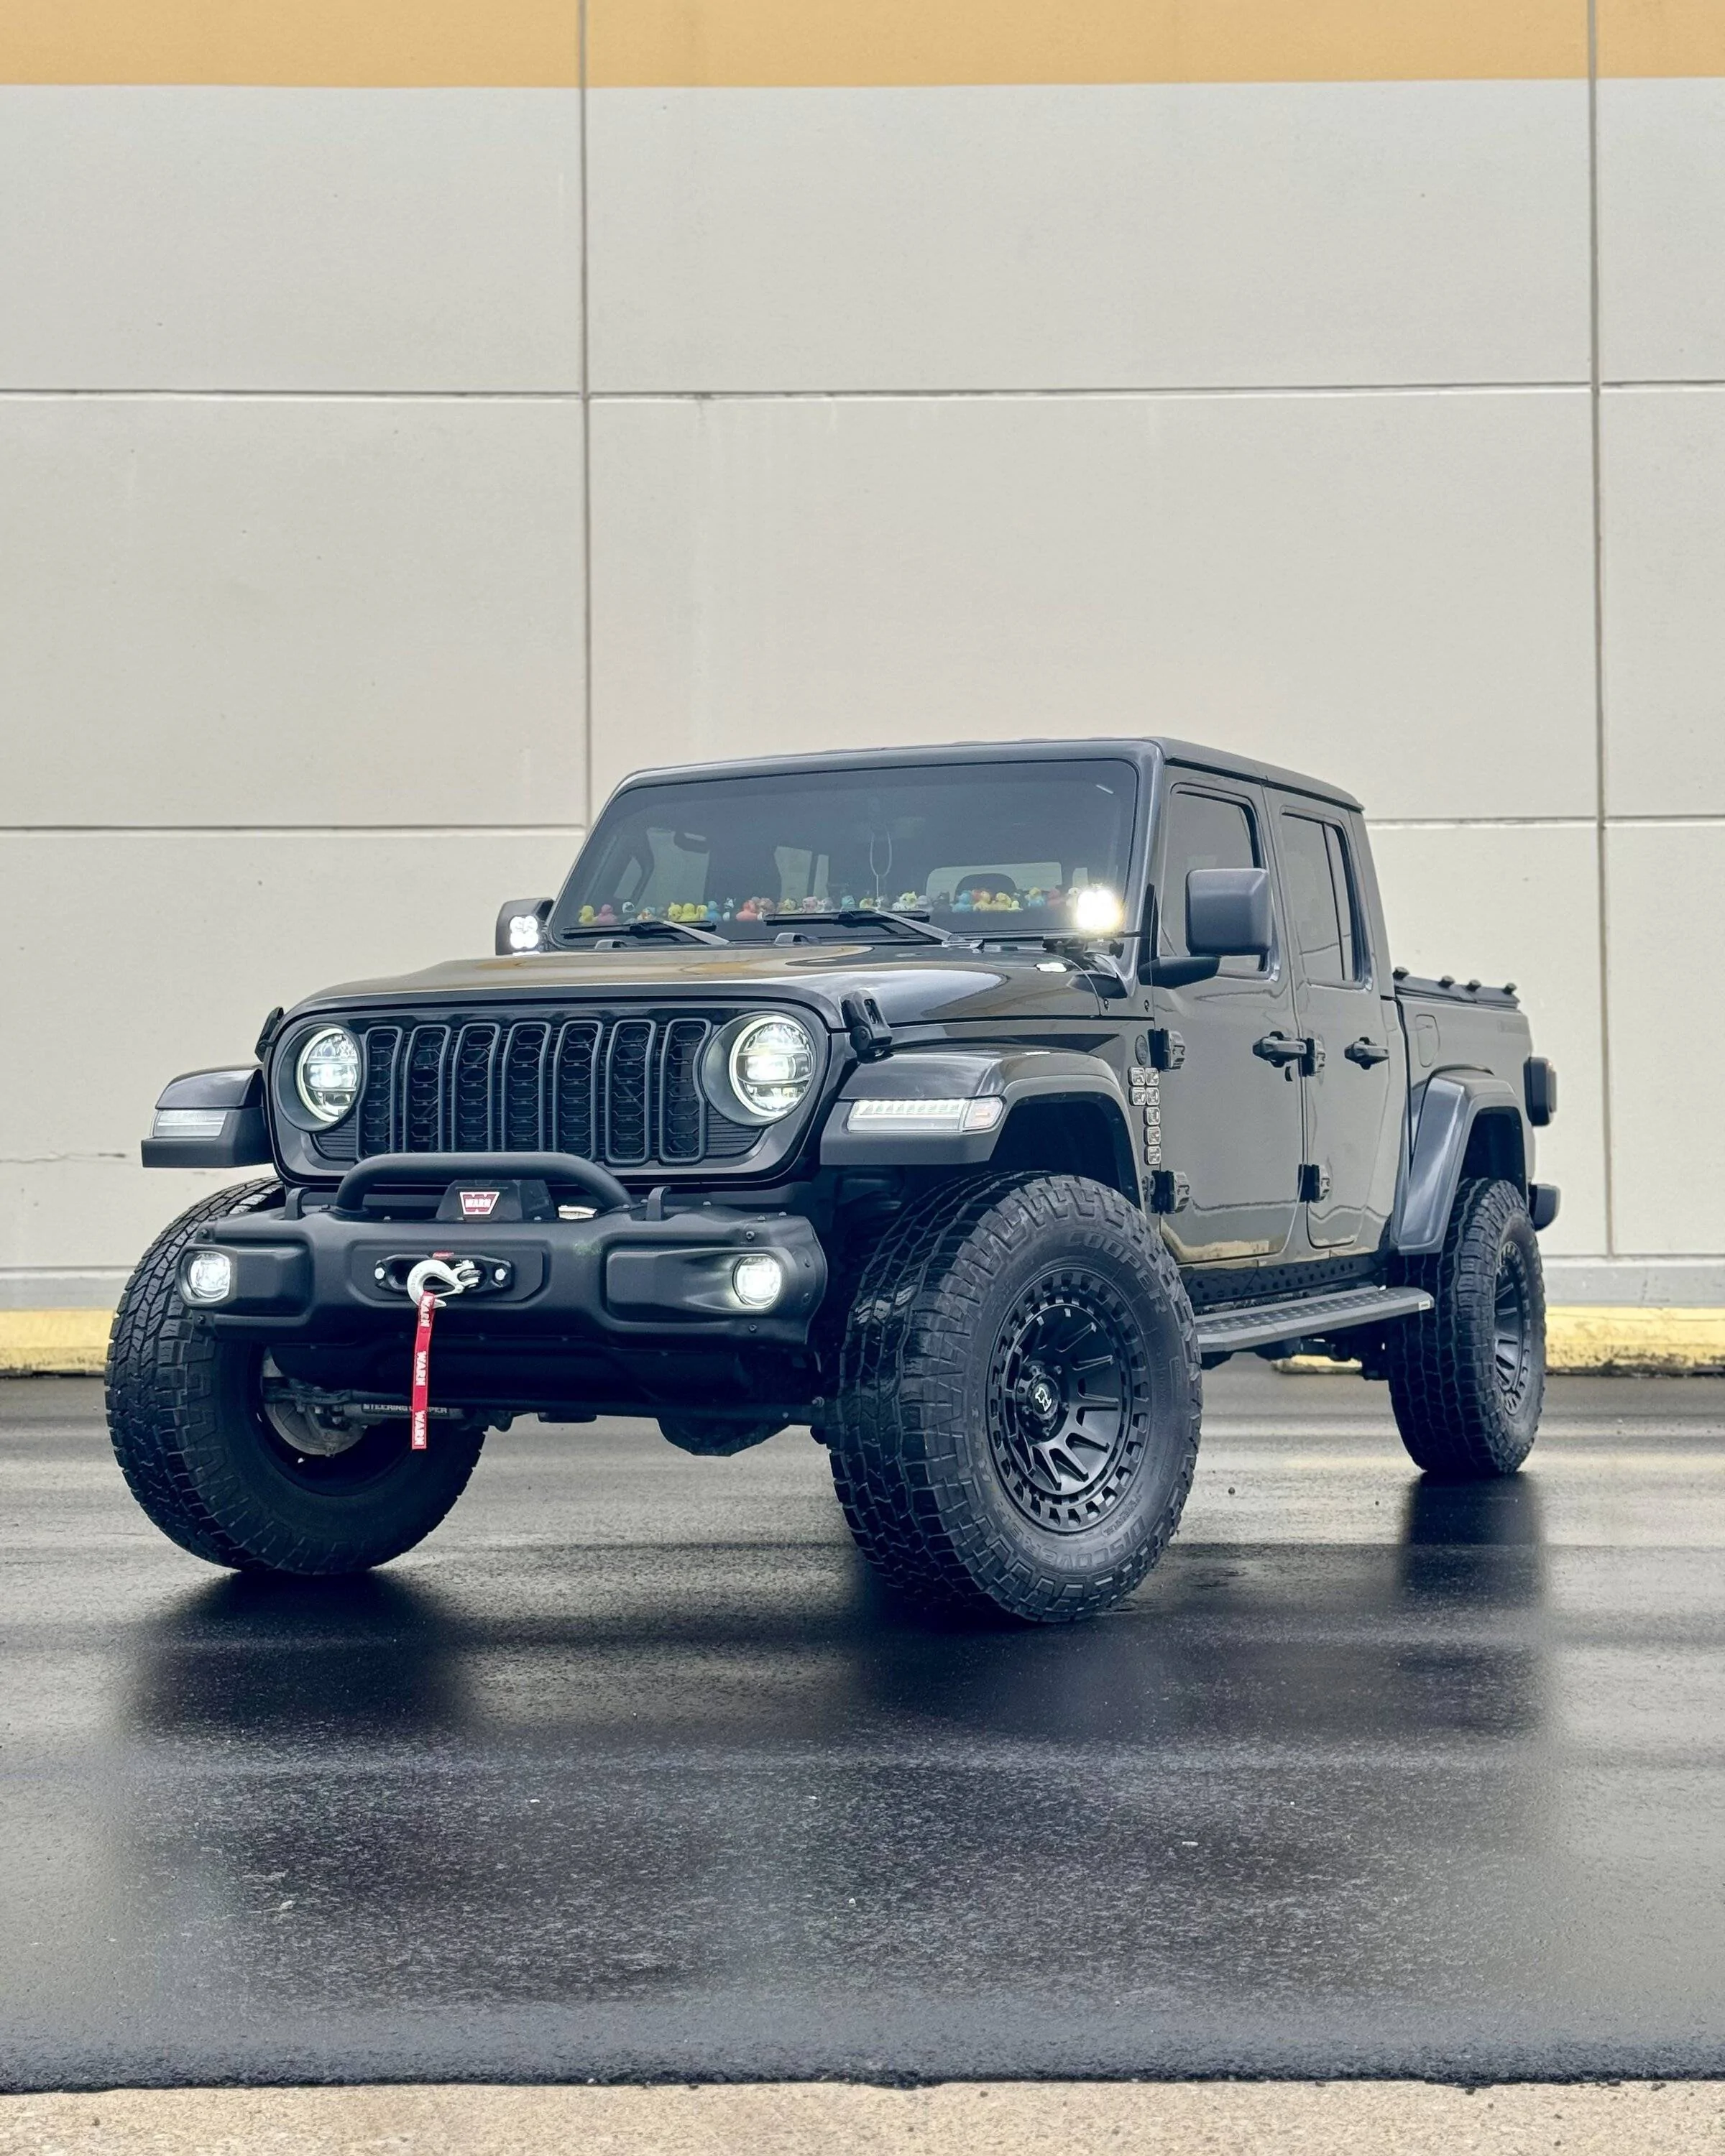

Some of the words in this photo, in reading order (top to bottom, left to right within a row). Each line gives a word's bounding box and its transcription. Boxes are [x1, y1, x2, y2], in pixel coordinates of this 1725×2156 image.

[1069, 1231, 1169, 1315] COOPER
[420, 1295, 433, 1328] WARN
[415, 1350, 427, 1386] WARN
[363, 1403, 408, 1411] STEERING
[414, 1410, 426, 1445] WARN
[994, 1501, 1146, 1570] DISCOVERER
